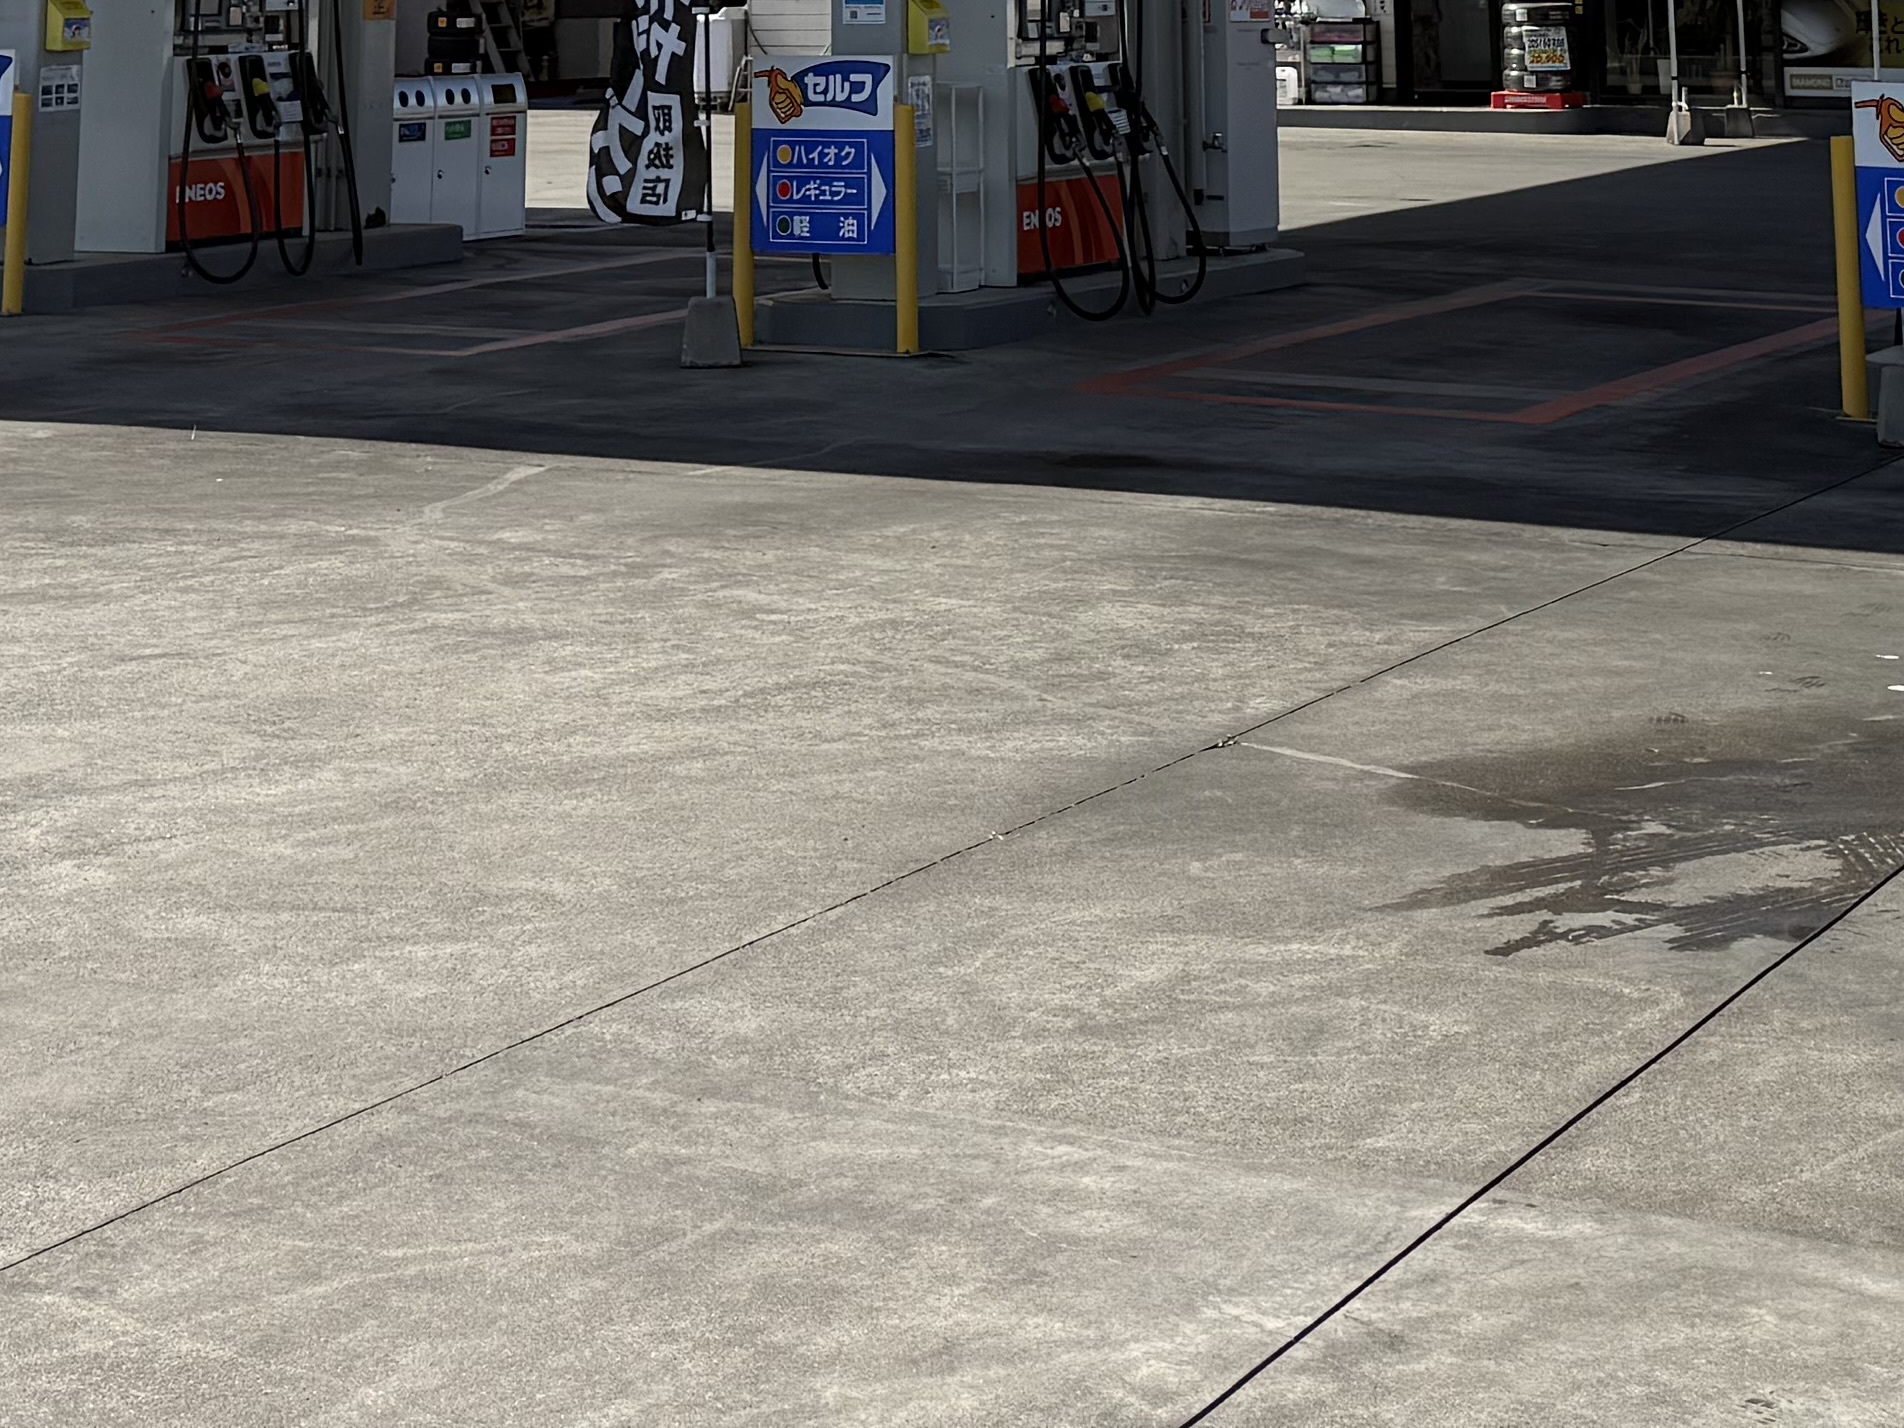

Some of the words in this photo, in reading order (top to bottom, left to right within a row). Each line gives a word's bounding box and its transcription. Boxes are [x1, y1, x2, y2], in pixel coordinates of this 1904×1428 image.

[803, 72, 874, 103] セルフ
[792, 144, 857, 167] ハイオク
[791, 180, 859, 201] レギュラー
[1022, 205, 1063, 232] ENOS
